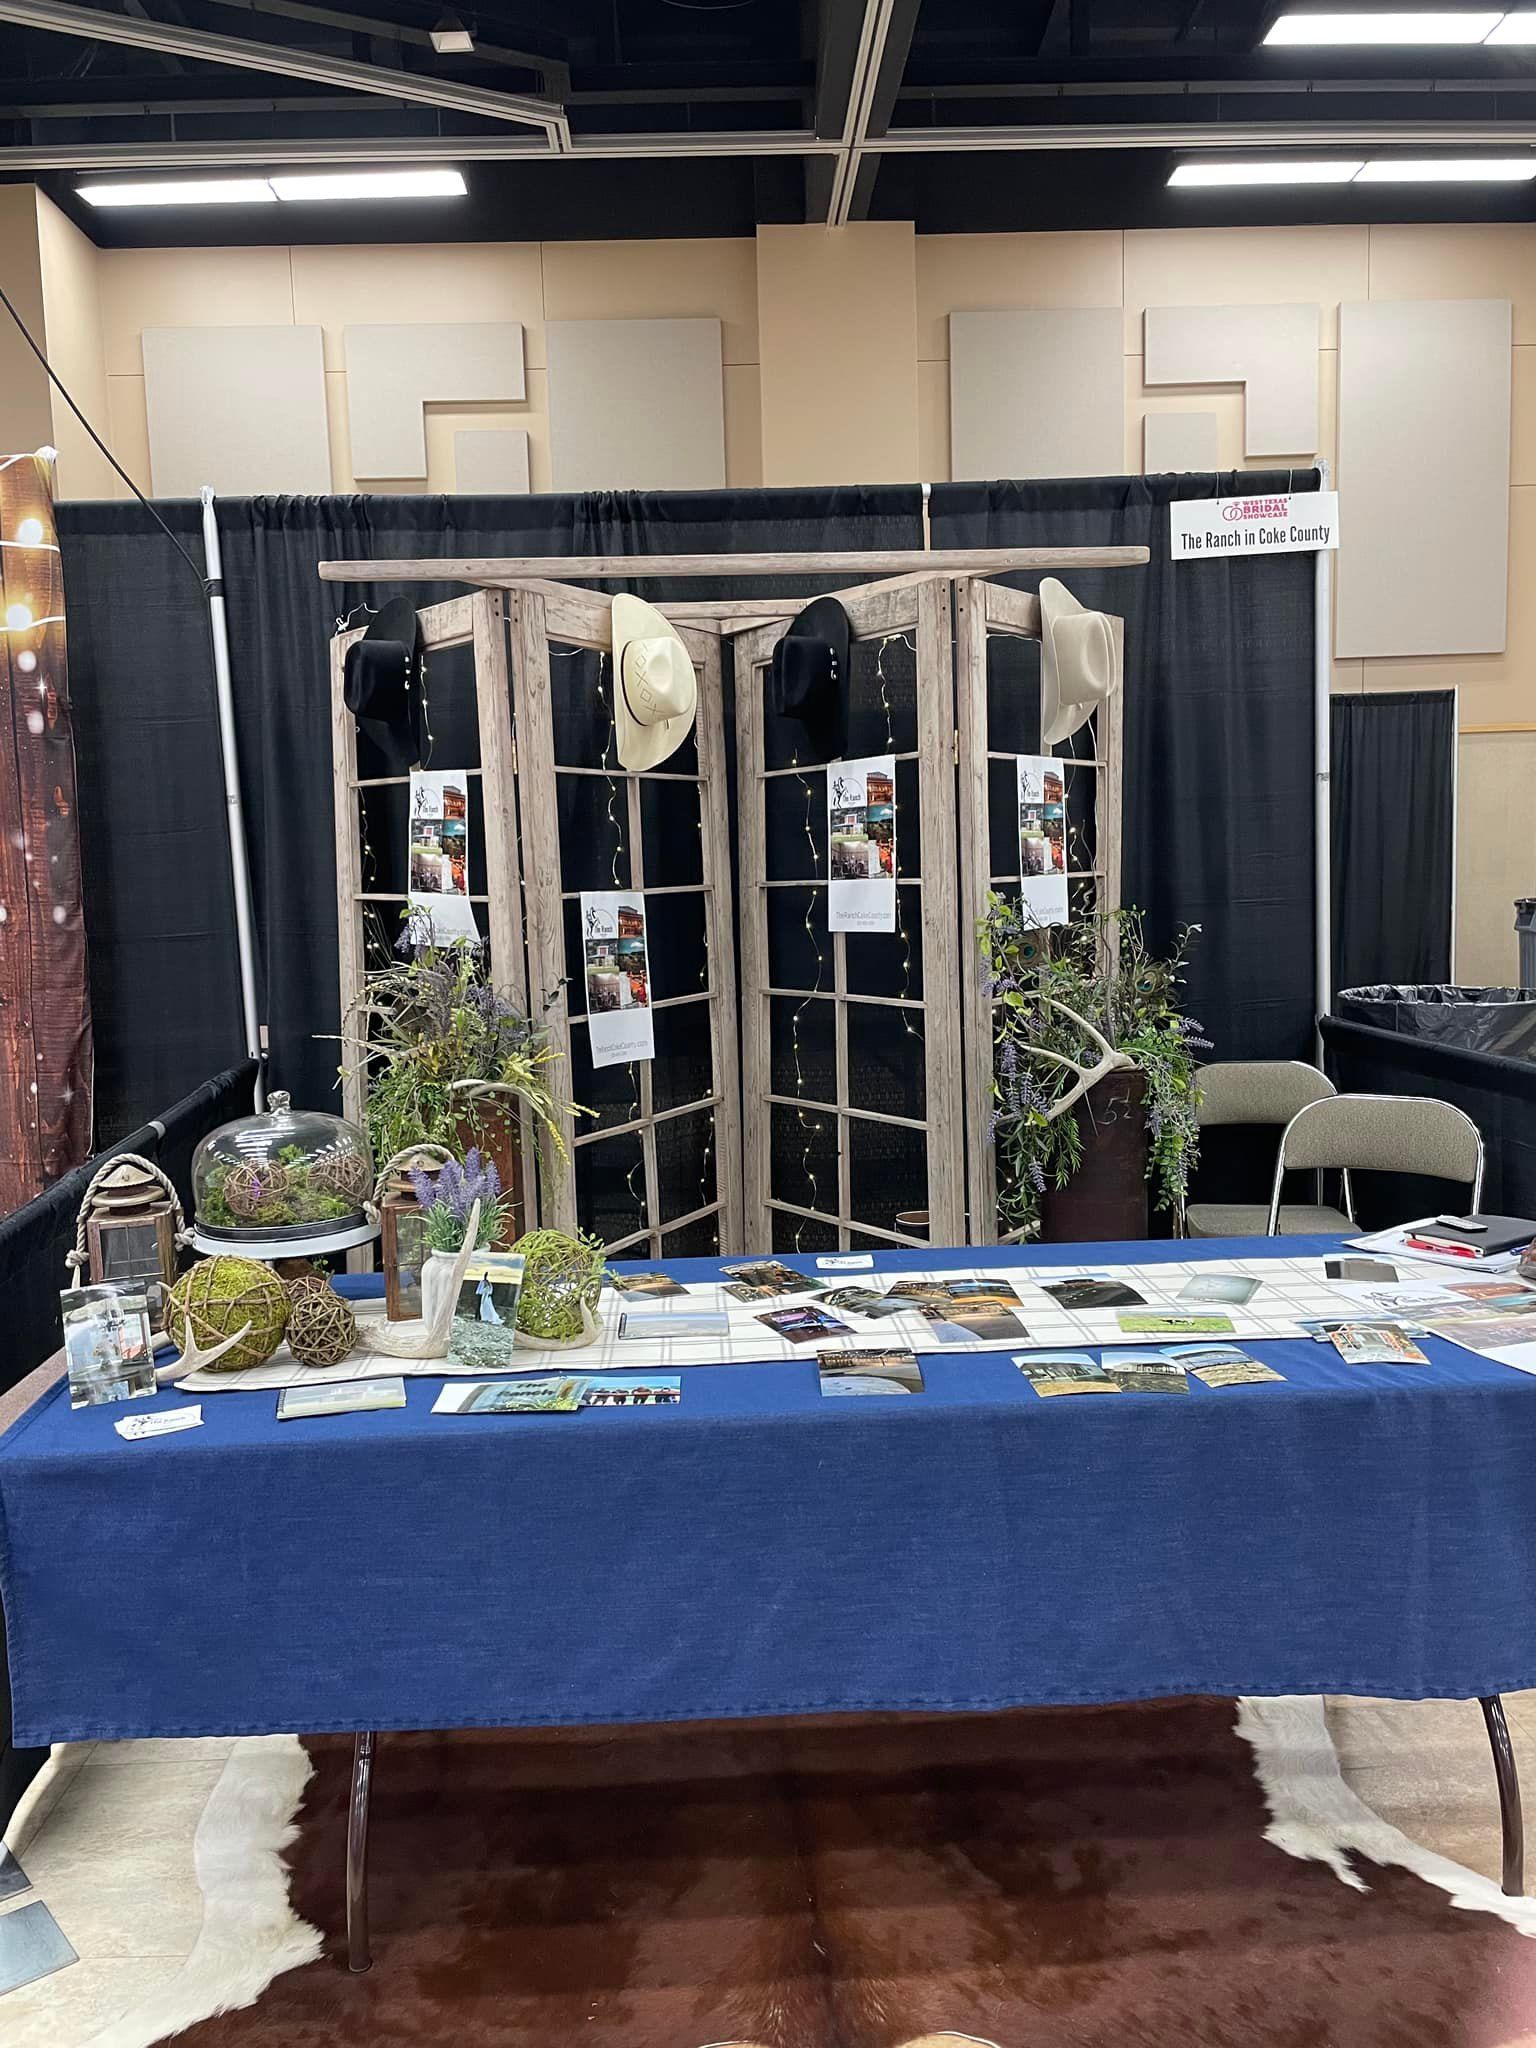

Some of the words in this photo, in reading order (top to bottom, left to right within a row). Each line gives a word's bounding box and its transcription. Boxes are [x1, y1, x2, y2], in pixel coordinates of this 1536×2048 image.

[1243, 504, 1288, 514] BRIDAL
[1243, 511, 1288, 520] SHOWCASE
[1181, 533, 1202, 550] The
[1206, 530, 1241, 548] Ranch
[1245, 529, 1255, 546] in
[1259, 527, 1286, 544] Coke
[1290, 525, 1330, 544] County
